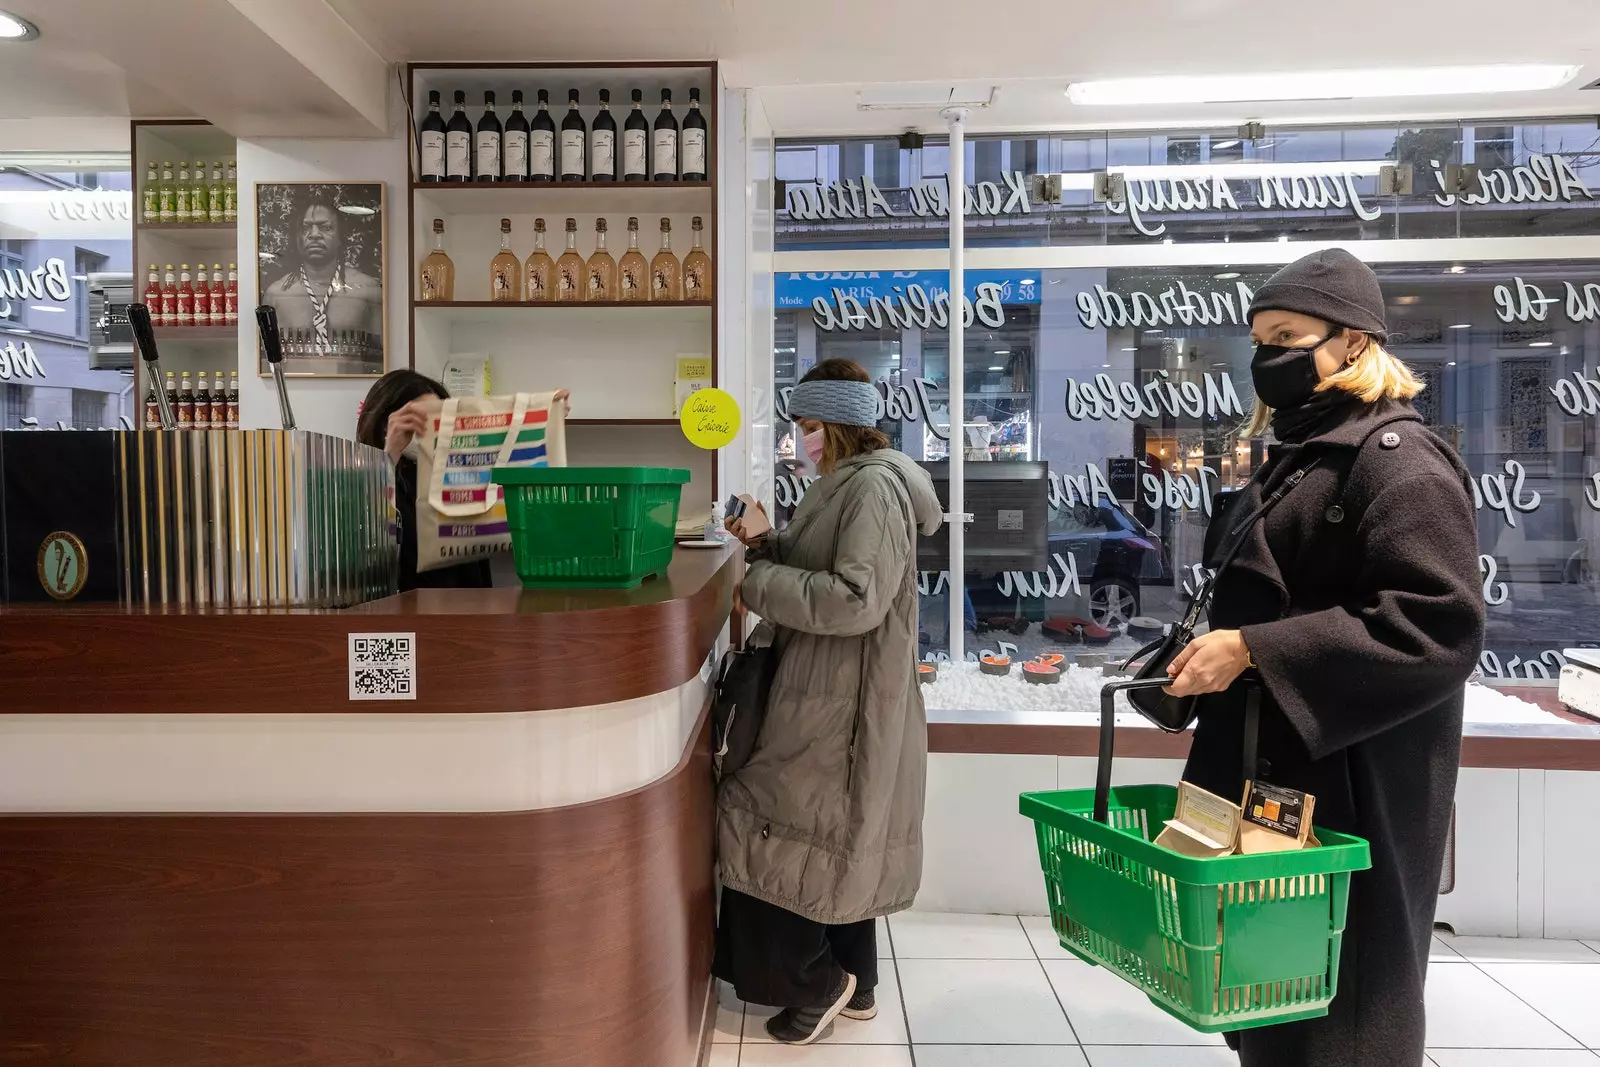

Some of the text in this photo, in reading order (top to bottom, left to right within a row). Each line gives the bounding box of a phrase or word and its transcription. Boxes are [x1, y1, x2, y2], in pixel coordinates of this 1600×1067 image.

[1018, 285, 1035, 300] 58
[779, 296, 803, 305] Mode
[905, 358, 917, 367] 78
[692, 397, 716, 413] Caisse
[451, 435, 480, 448] EIJING
[465, 451, 501, 466] MOULIN
[449, 489, 473, 503] ROMA
[452, 524, 477, 537] PARIS
